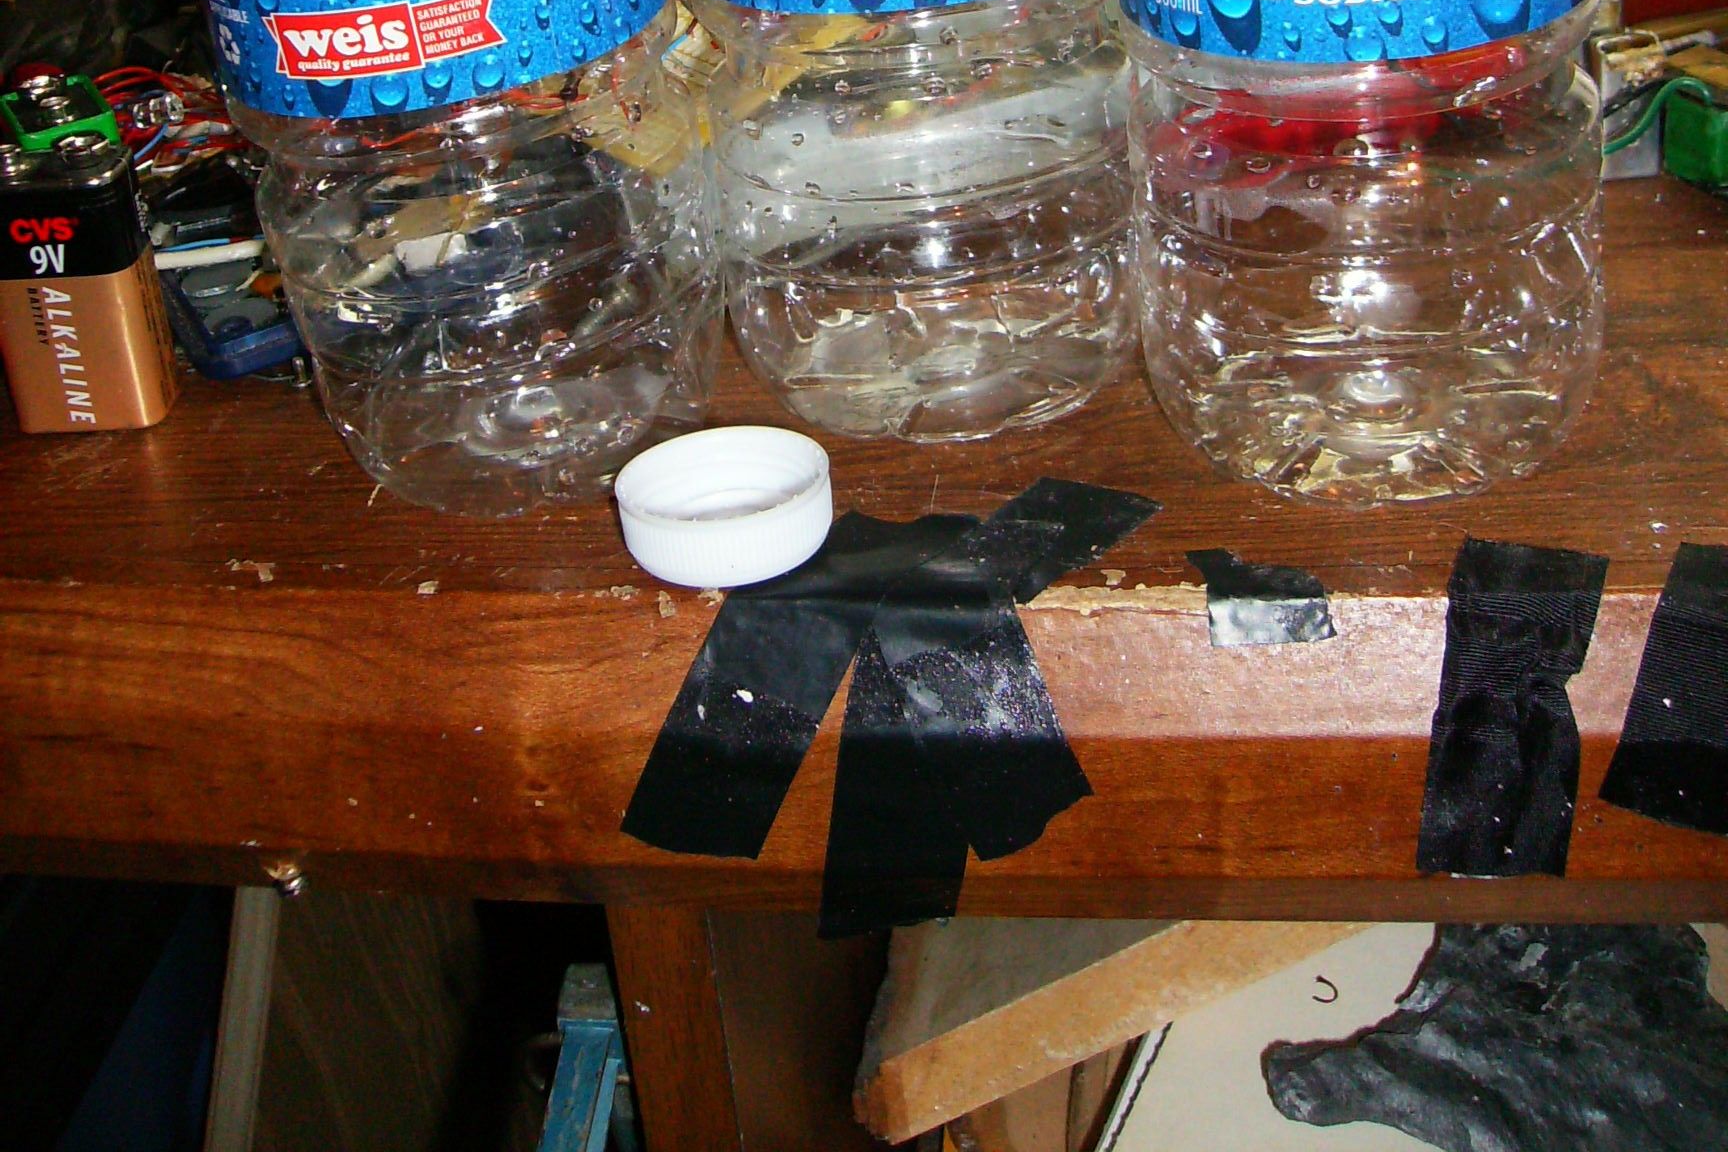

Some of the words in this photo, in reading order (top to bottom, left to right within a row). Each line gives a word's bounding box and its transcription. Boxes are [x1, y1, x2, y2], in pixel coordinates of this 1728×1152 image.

[419, 9, 480, 32] GUARANTEED
[283, 14, 409, 57] weis
[423, 32, 436, 43] OR
[438, 26, 464, 41] YOUR
[425, 40, 458, 55] MONEY
[460, 33, 485, 47] BACK
[297, 59, 340, 72] quality
[343, 52, 410, 71] guarantee
[9, 217, 75, 243] CVS
[29, 244, 64, 275] 9V
[27, 287, 49, 346] BATTERY
[42, 287, 96, 425] ALKALINE
